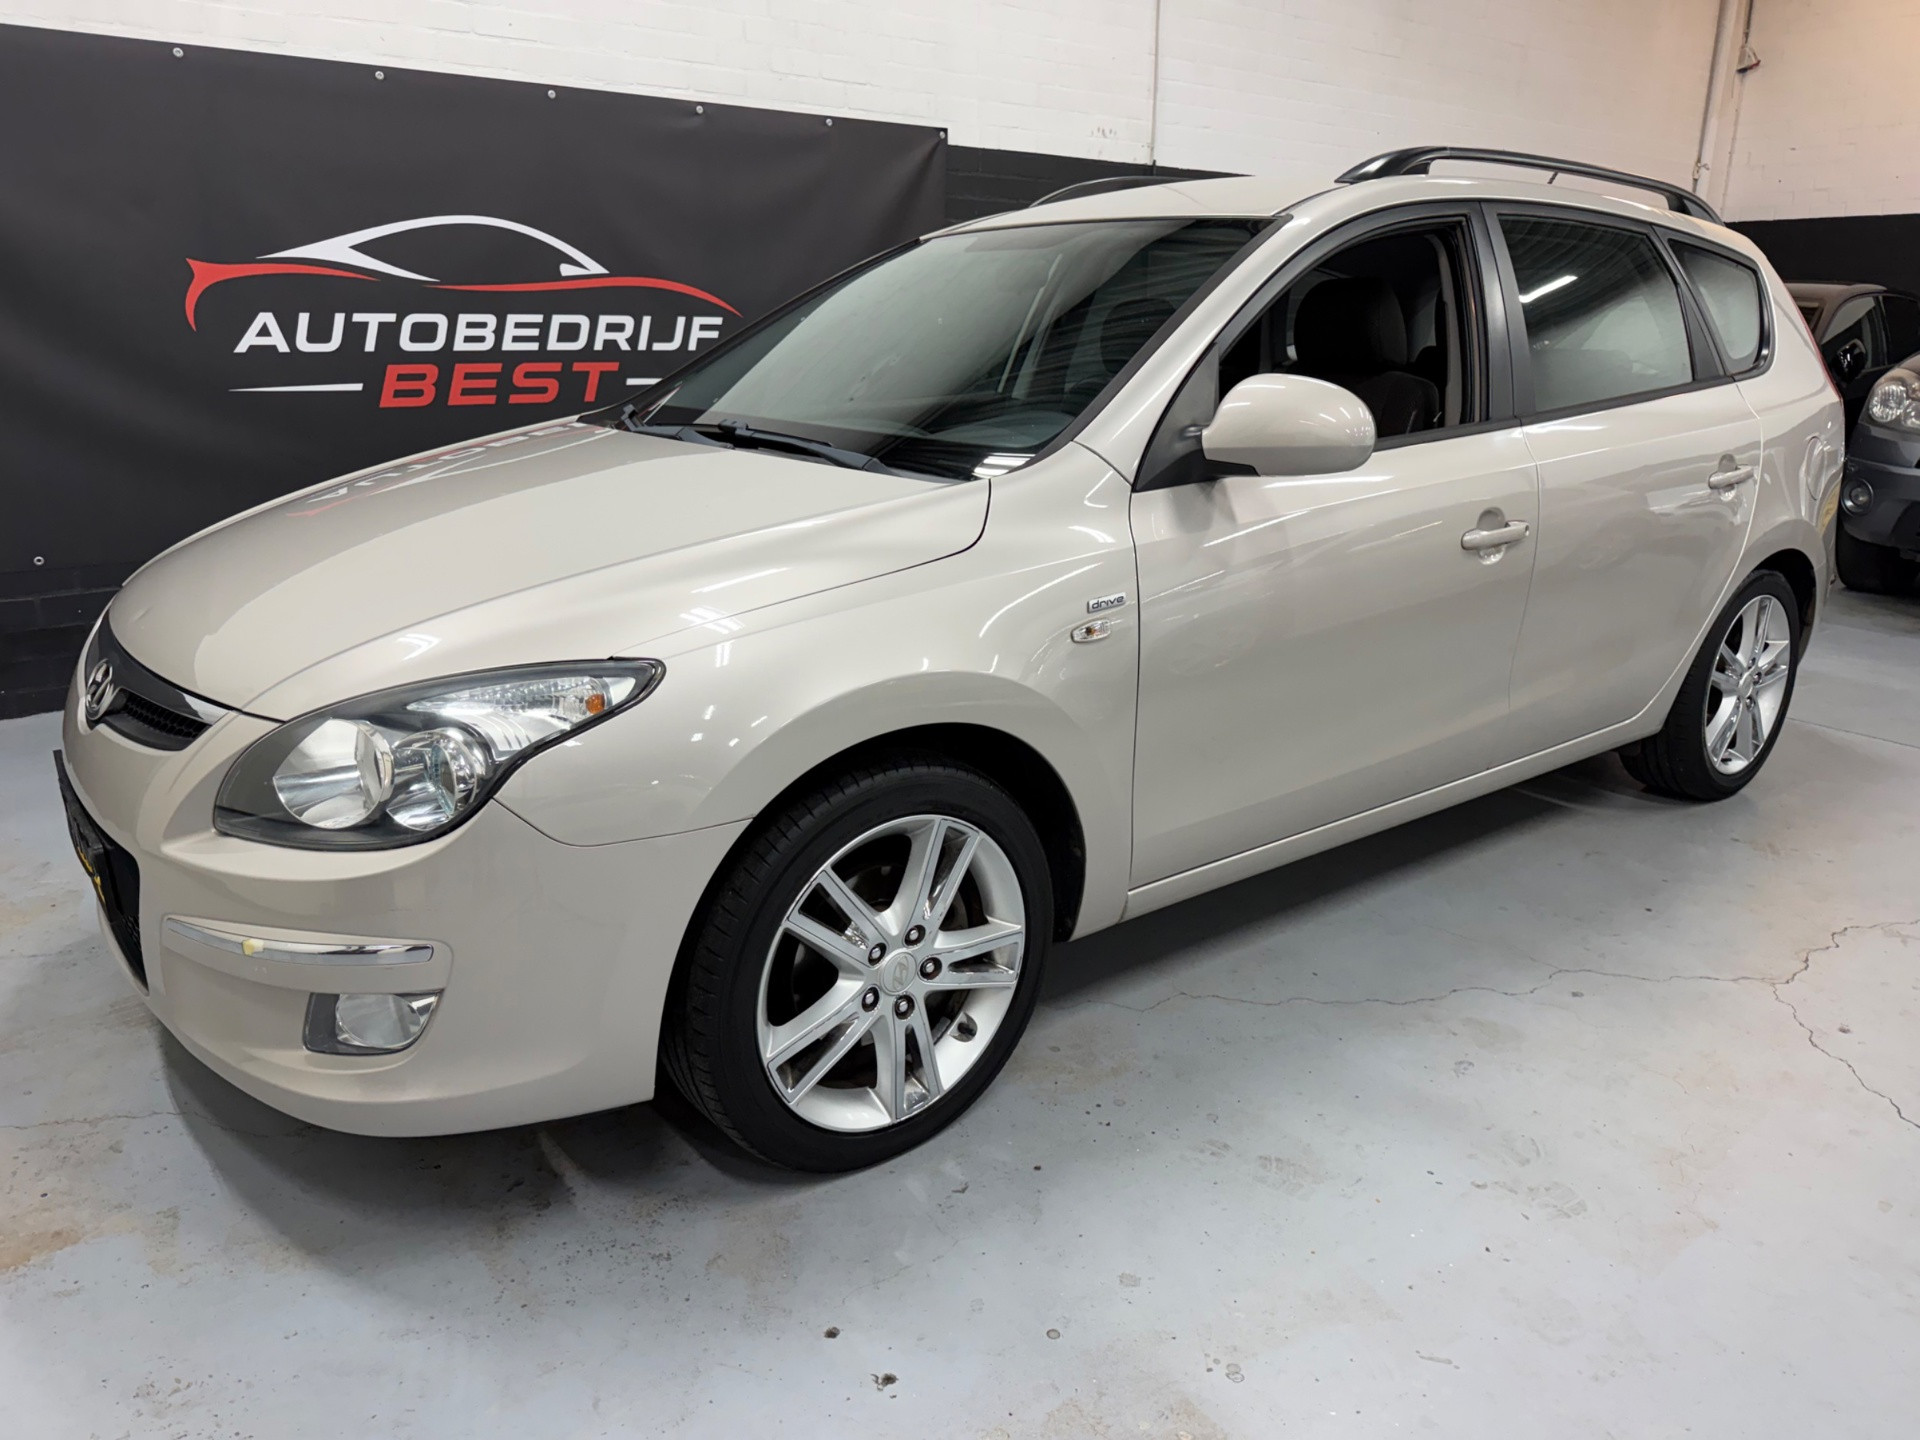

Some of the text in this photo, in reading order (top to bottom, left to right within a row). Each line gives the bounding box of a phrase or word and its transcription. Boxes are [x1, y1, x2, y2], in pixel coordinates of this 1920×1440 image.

[233, 311, 724, 353] AUTOBEDRIJF
[379, 361, 620, 408] BEST
[1092, 595, 1124, 609] drive
